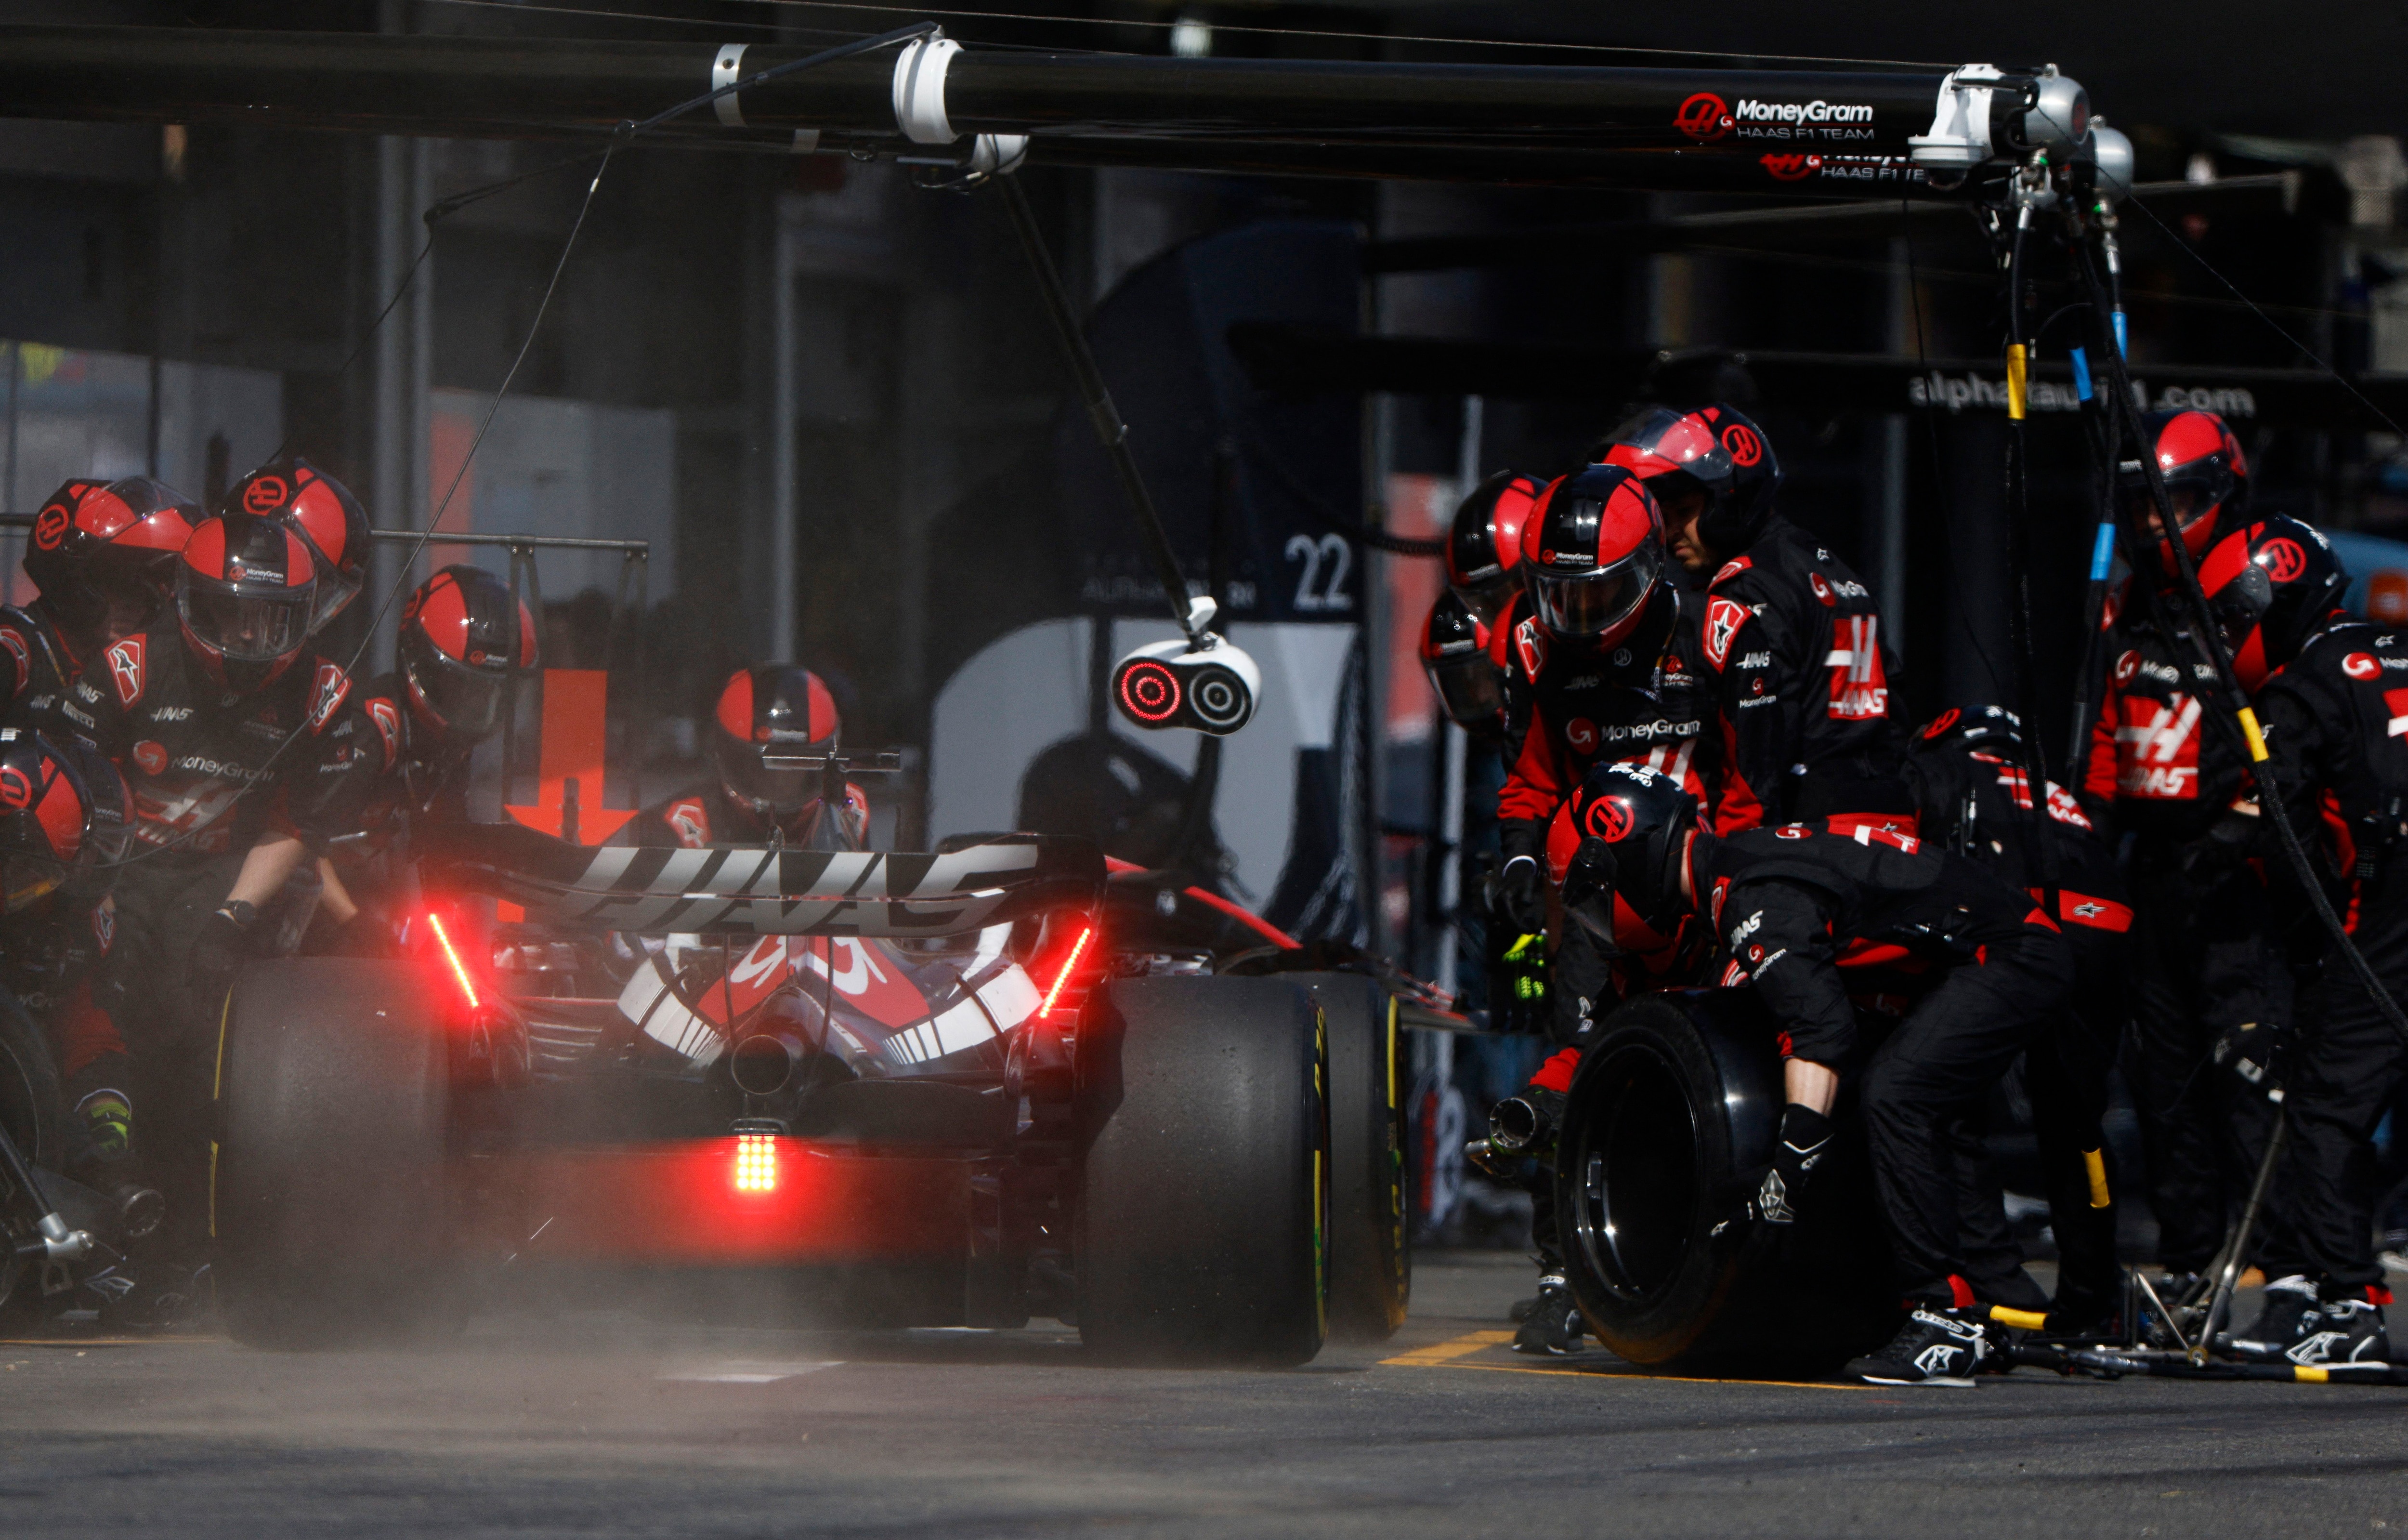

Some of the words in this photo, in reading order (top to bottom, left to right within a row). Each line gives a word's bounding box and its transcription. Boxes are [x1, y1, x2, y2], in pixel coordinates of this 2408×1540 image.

[1736, 99, 1873, 127] MoneyGram
[1736, 127, 1792, 140] HAAS
[1795, 128, 1815, 140] F1
[1818, 129, 1875, 141] TEAM
[1820, 166, 1875, 182] HAAS
[1878, 168, 1897, 182] F1
[1284, 532, 1354, 612] 22
[1736, 651, 1771, 669] HAAS
[1739, 695, 1777, 709] MoneyGram
[1828, 687, 1888, 716] HAAS
[1600, 718, 1701, 742] MoneyGram
[554, 843, 1039, 937] HAAS
